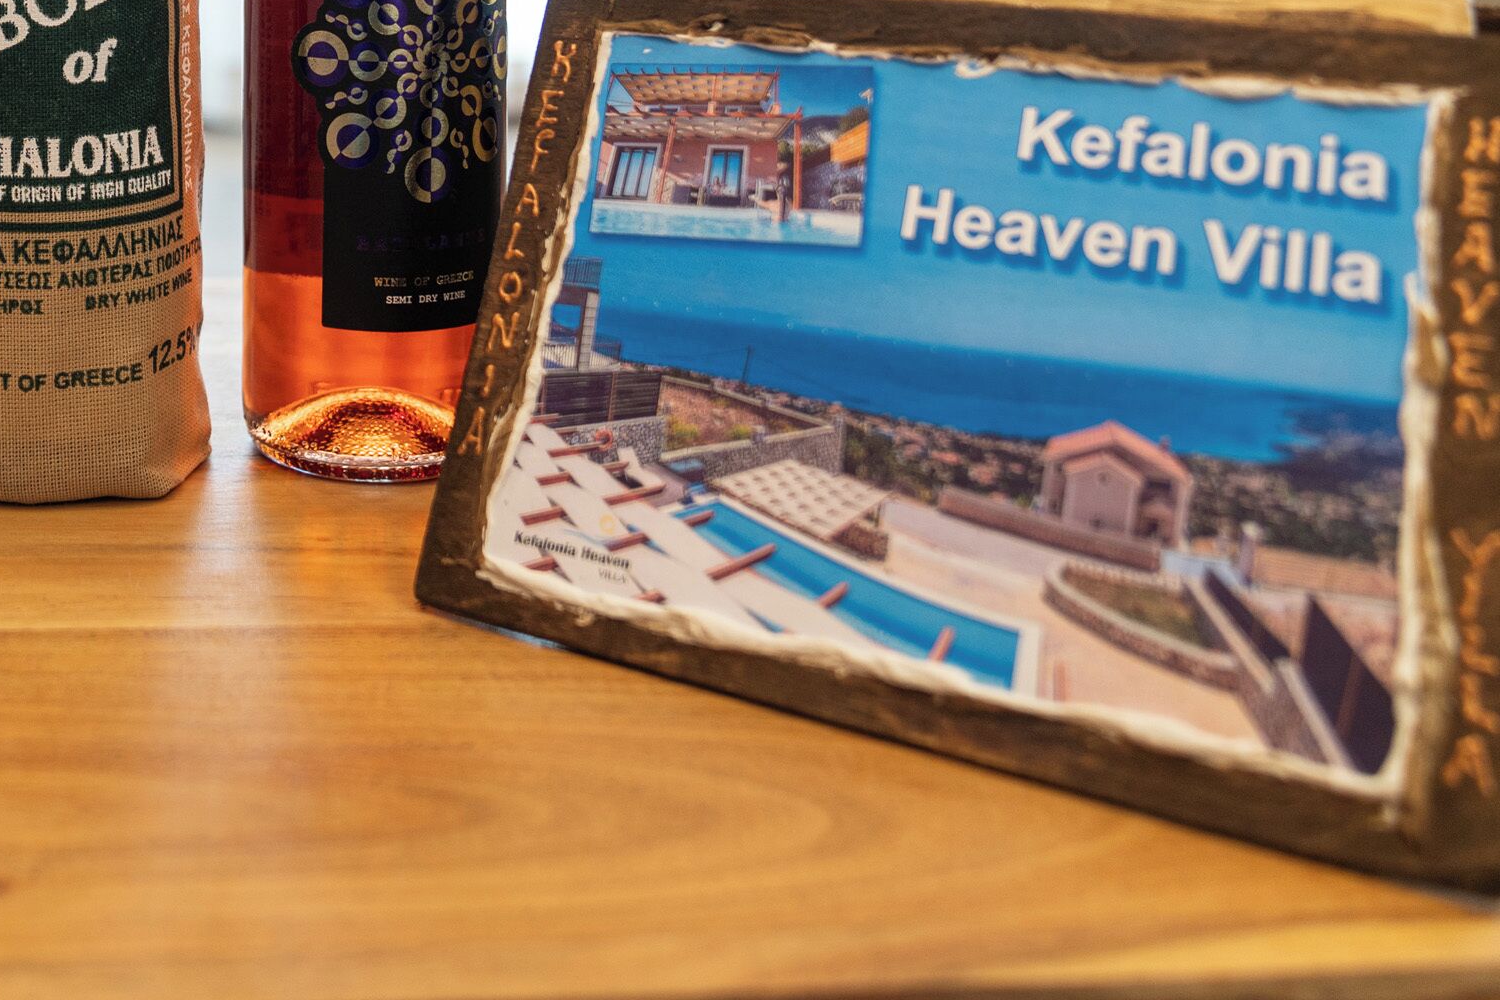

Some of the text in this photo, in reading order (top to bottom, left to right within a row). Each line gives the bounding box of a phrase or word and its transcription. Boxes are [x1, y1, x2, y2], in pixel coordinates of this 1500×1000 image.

[62, 37, 118, 85] of
[1016, 105, 1389, 202] Kefalonia
[11, 185, 62, 203] ORIGIN
[67, 183, 86, 201] OF
[90, 181, 124, 200] HIGH
[128, 168, 172, 194] QUALITY
[902, 184, 1383, 305] Heaven Villa
[85, 268, 193, 311] DRY WHITE WINE
[374, 270, 475, 287] WINE OF GREECE
[386, 290, 466, 305] SEMI DRY WINE
[17, 374, 47, 393] OF
[54, 362, 143, 389] GREECE
[514, 530, 630, 569] Kefalonia Heaven
